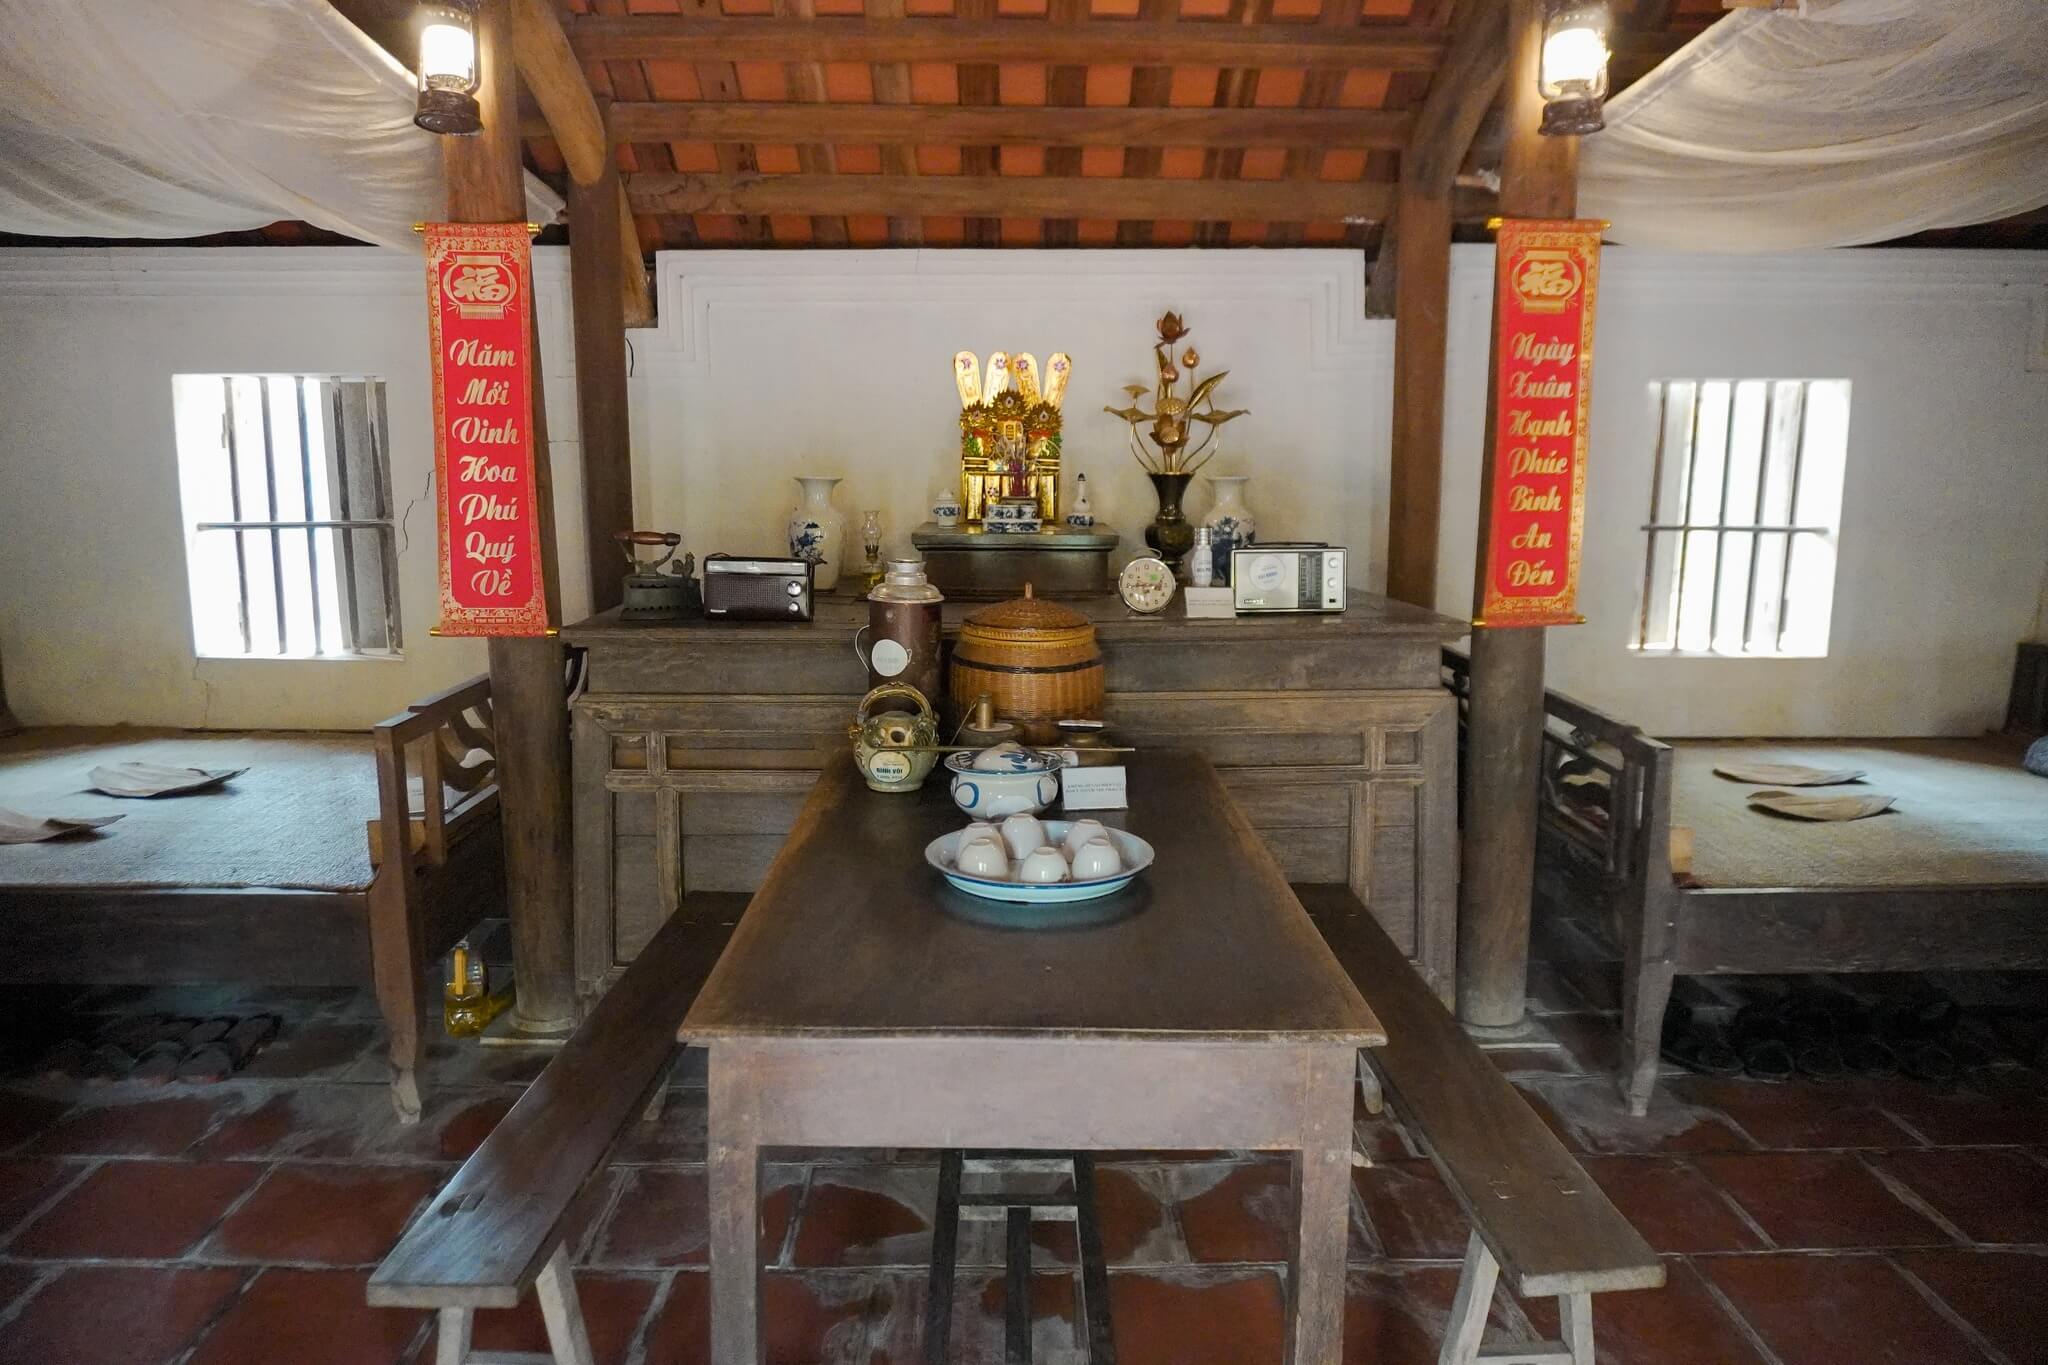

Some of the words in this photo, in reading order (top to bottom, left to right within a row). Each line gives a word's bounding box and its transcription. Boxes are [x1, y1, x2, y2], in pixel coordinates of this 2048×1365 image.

[453, 266, 510, 302] 福
[450, 339, 517, 367] Năm
[1511, 331, 1576, 366] Ngày
[457, 378, 510, 406] Mới
[1510, 370, 1574, 400] Xuân
[451, 416, 520, 445] Vinh
[1508, 409, 1574, 443] Hạnh
[459, 455, 518, 483] Hoa
[1508, 446, 1569, 478] Phúc
[459, 493, 520, 526] Phú
[1509, 485, 1563, 513] Bình
[465, 531, 517, 565] Quý
[1511, 522, 1553, 549] An
[471, 568, 513, 597] Về
[1508, 560, 1556, 587] Đến
